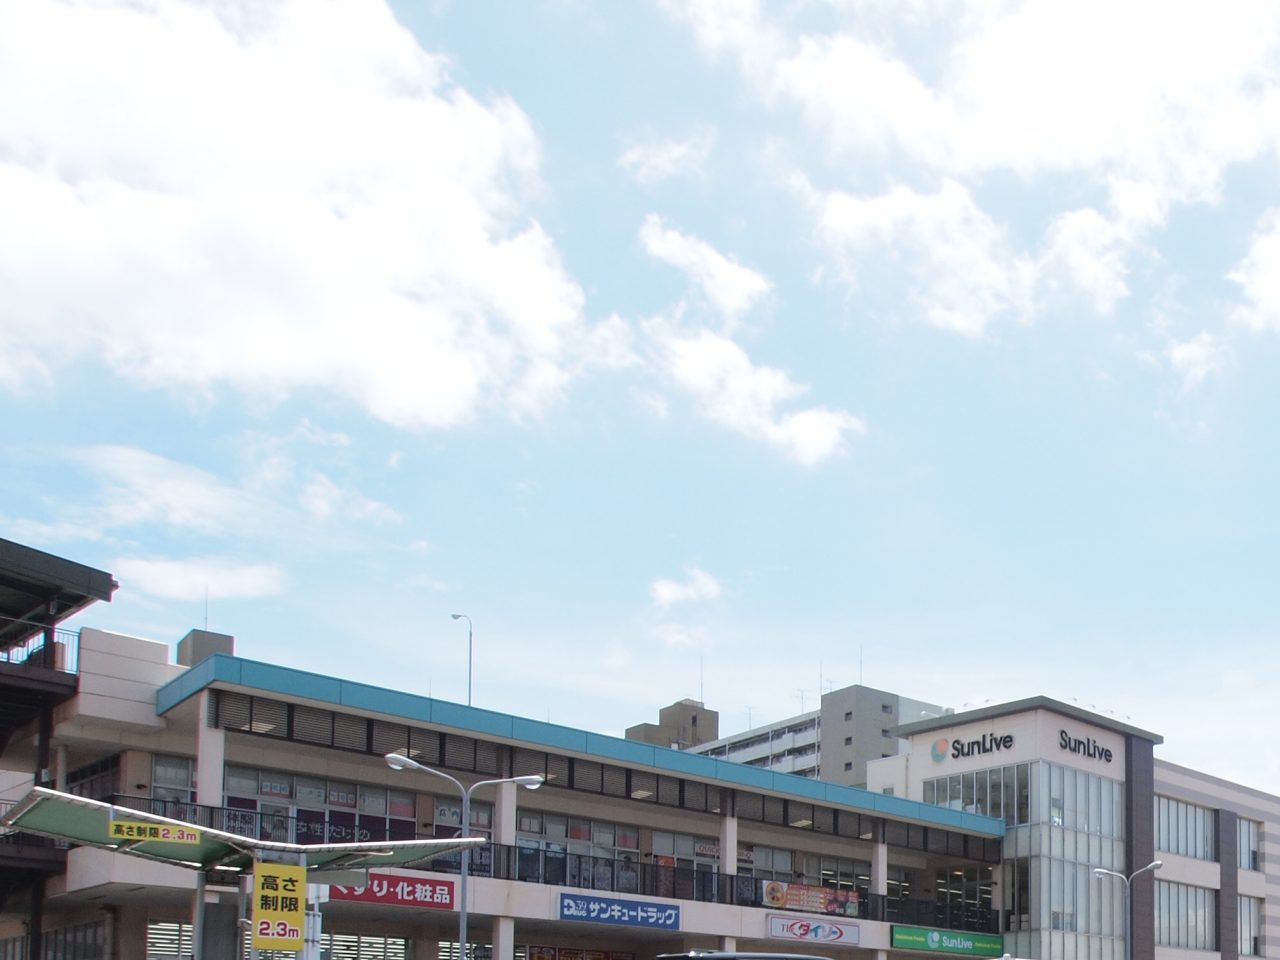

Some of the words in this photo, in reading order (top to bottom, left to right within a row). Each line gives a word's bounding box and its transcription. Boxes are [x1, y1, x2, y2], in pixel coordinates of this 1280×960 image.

[952, 732, 1014, 759] SunLive
[1060, 729, 1113, 763] SunLive
[261, 874, 299, 892] 高さ
[260, 896, 299, 912] 制限
[589, 901, 678, 925] サンキュードラッグ
[258, 921, 299, 939] 2.3m
[942, 936, 973, 949] SunLive
